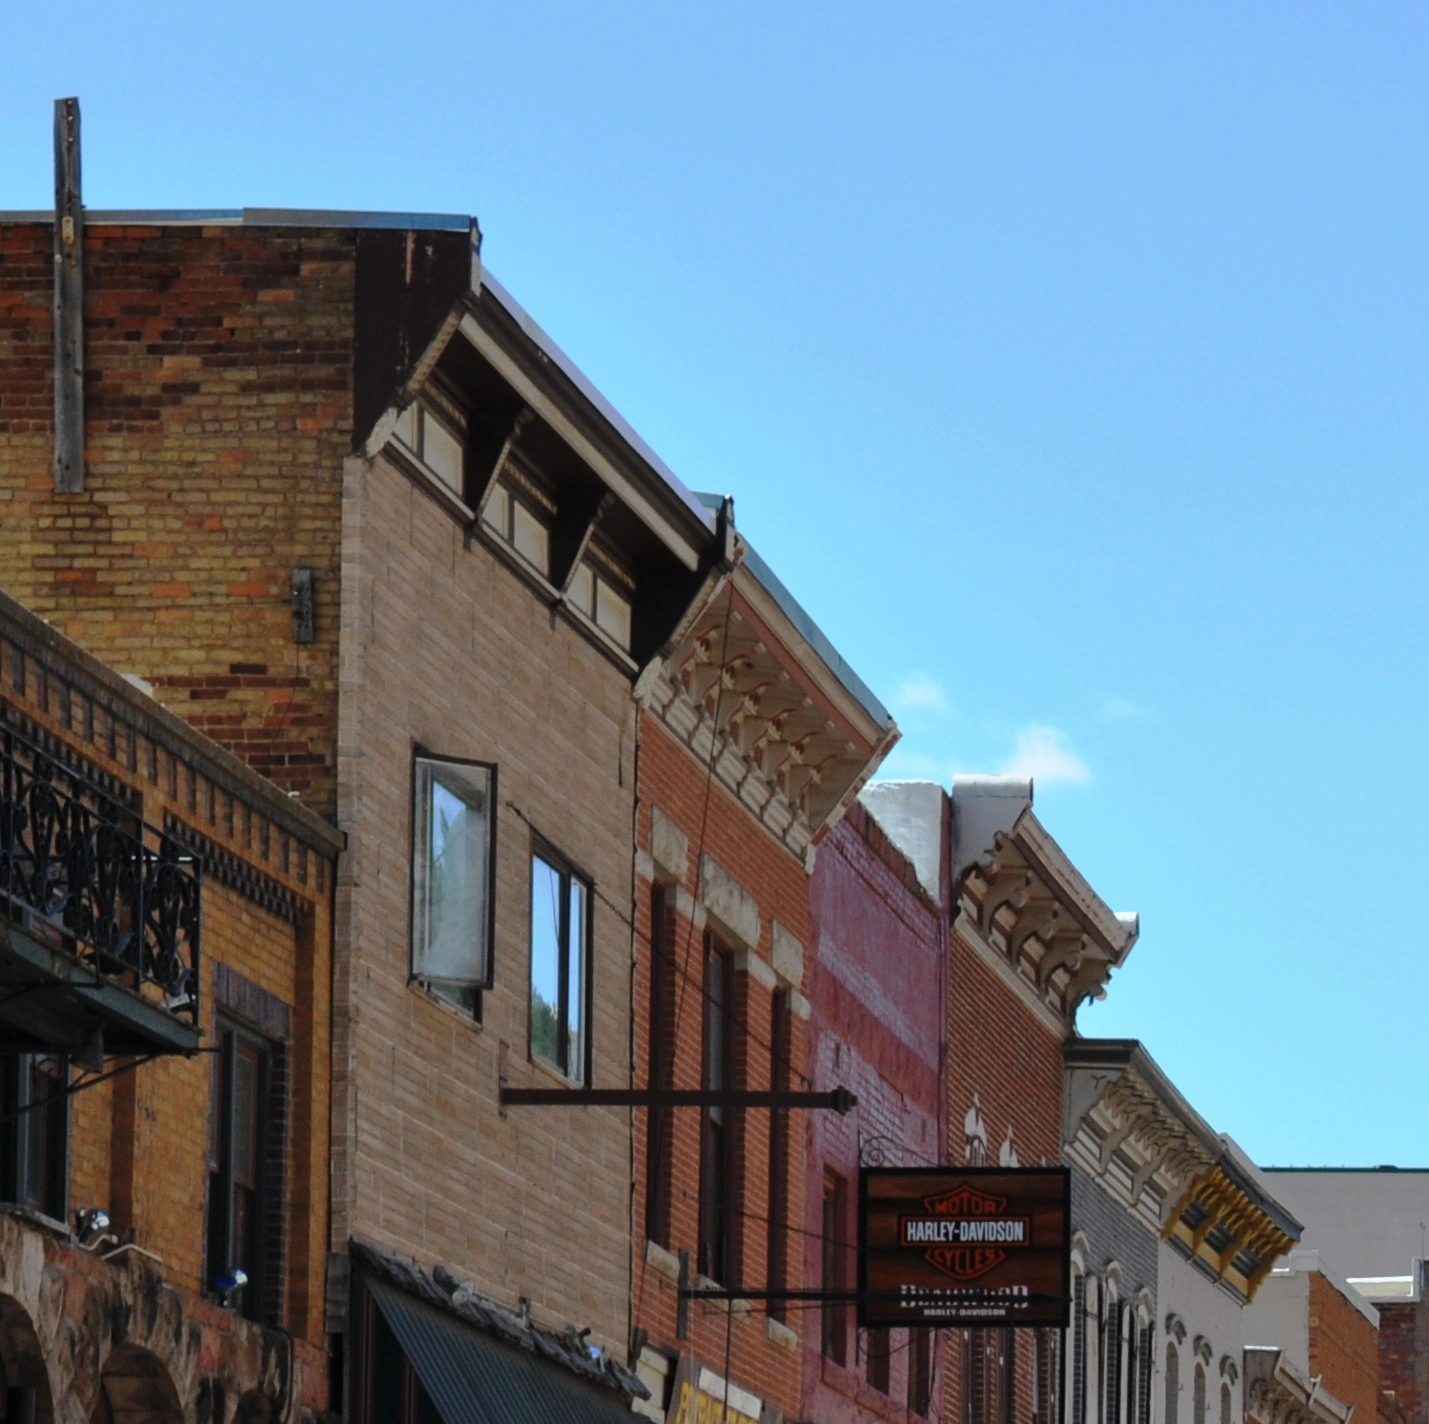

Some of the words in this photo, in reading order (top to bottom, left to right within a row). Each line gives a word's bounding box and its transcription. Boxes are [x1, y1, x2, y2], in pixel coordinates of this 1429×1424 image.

[935, 1191, 997, 1213] MOTOR
[907, 1221, 1024, 1242] HARLEY-DAVIDSON
[935, 1250, 996, 1274] CYCLES
[923, 1308, 1006, 1316] HARLEY-DAVIDSON
